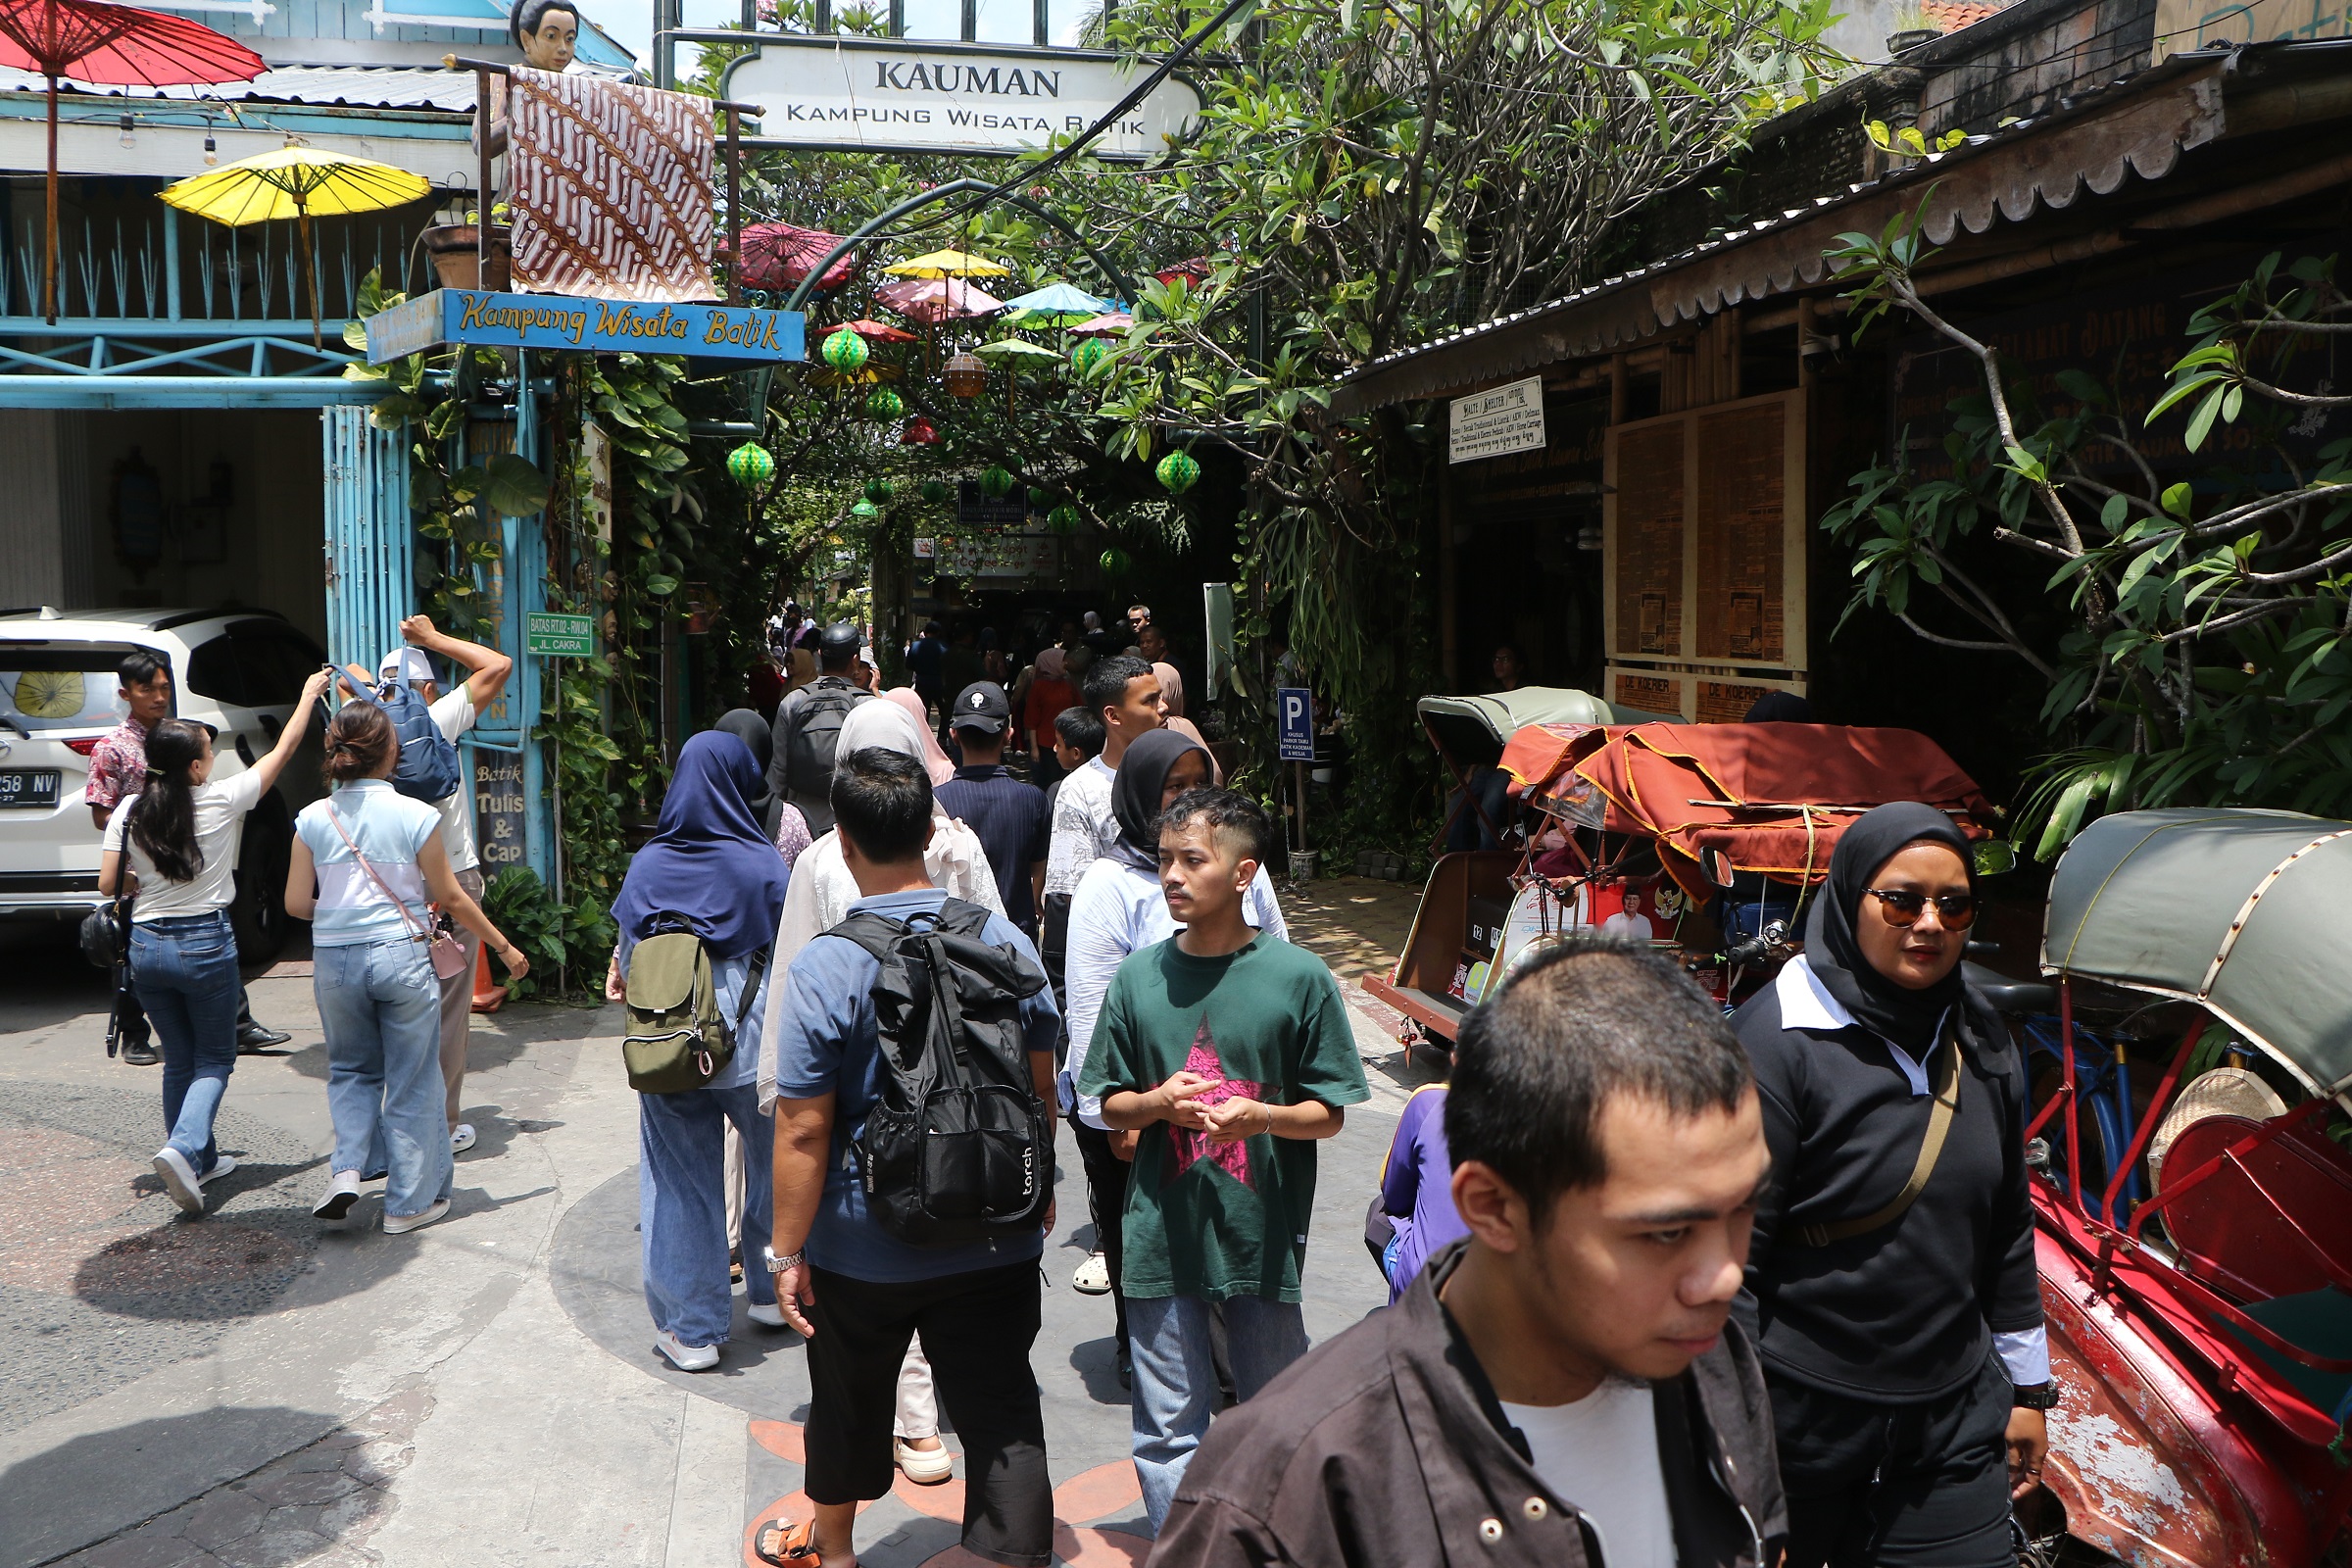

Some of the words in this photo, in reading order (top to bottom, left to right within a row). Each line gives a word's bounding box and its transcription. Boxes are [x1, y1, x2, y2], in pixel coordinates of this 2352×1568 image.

[875, 61, 1061, 98] KAUMAN
[786, 104, 931, 123] KAMPUNG
[947, 109, 1051, 131] WISATA
[459, 295, 586, 344] Kampung
[594, 302, 687, 338] Wisata
[704, 310, 782, 351] Batik
[2081, 302, 2167, 359] DATANG
[1463, 403, 1479, 417] HALTE
[1483, 395, 1504, 414] SHELTER
[530, 617, 550, 632] BATAS
[553, 640, 581, 651] CAKRA
[1625, 675, 1634, 689] DE
[1638, 676, 1669, 693] KOERIER
[1708, 682, 1721, 697] DE
[1725, 684, 1767, 701] KOERIER
[1286, 696, 1302, 730] P
[0, 775, 22, 792] 58
[33, 775, 54, 792] NV
[477, 764, 523, 784] Batik
[477, 793, 524, 813] Tulis
[494, 818, 514, 839] &
[483, 843, 522, 863] Cap
[1474, 927, 1482, 939] 12
[1021, 1147, 1032, 1196] torch
